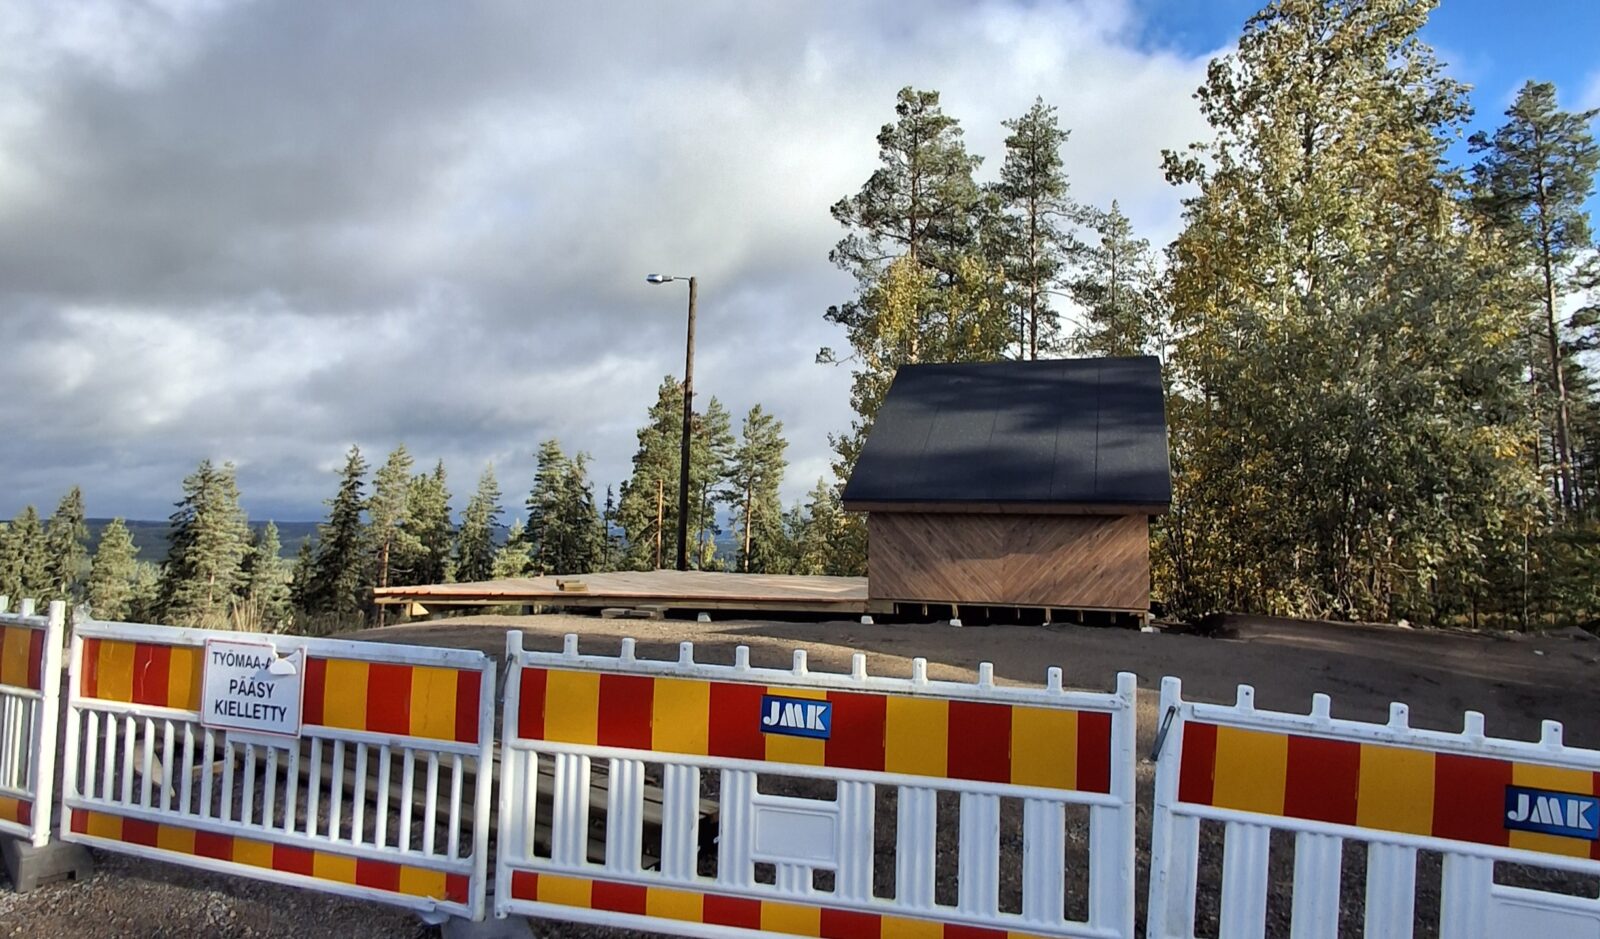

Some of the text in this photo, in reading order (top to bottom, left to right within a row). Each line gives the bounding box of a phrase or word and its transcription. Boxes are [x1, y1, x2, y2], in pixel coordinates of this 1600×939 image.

[212, 649, 297, 671] TYÖMAA-A
[229, 675, 275, 698] PÄÄSY
[214, 699, 287, 722] KIELLETTY
[762, 700, 828, 731] JMK
[1507, 793, 1593, 830] JMK
